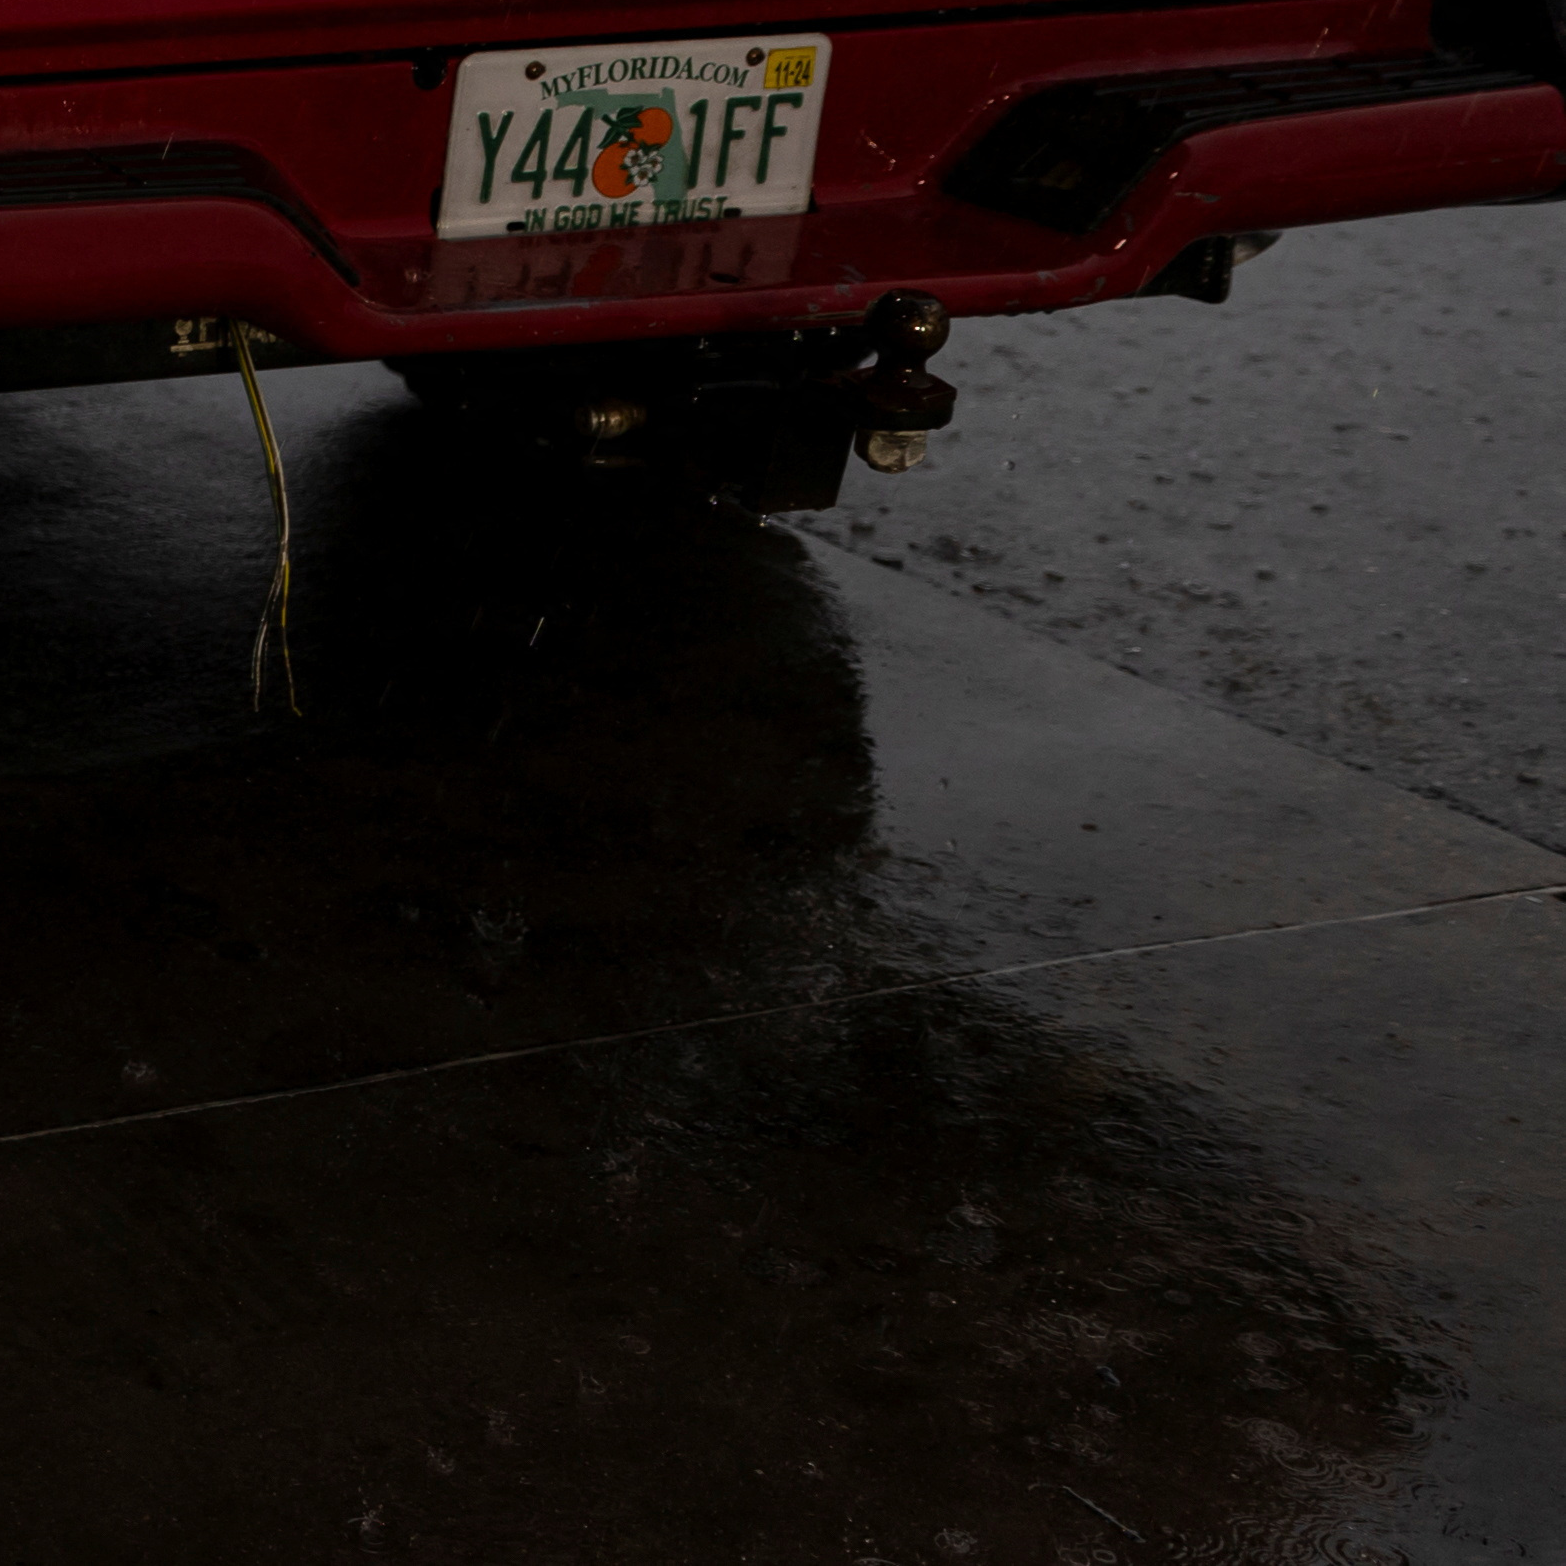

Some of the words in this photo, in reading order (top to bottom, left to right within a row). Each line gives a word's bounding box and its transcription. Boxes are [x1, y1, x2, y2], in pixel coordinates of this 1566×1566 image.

[540, 55, 750, 101] MYFLORIDA.COM
[773, 58, 812, 86] 11-24
[477, 105, 594, 204] Y44
[686, 91, 803, 190] 1FF
[523, 206, 549, 233] IN
[555, 204, 600, 231] GOD
[610, 202, 641, 227] WE
[652, 196, 729, 224] TRUST
